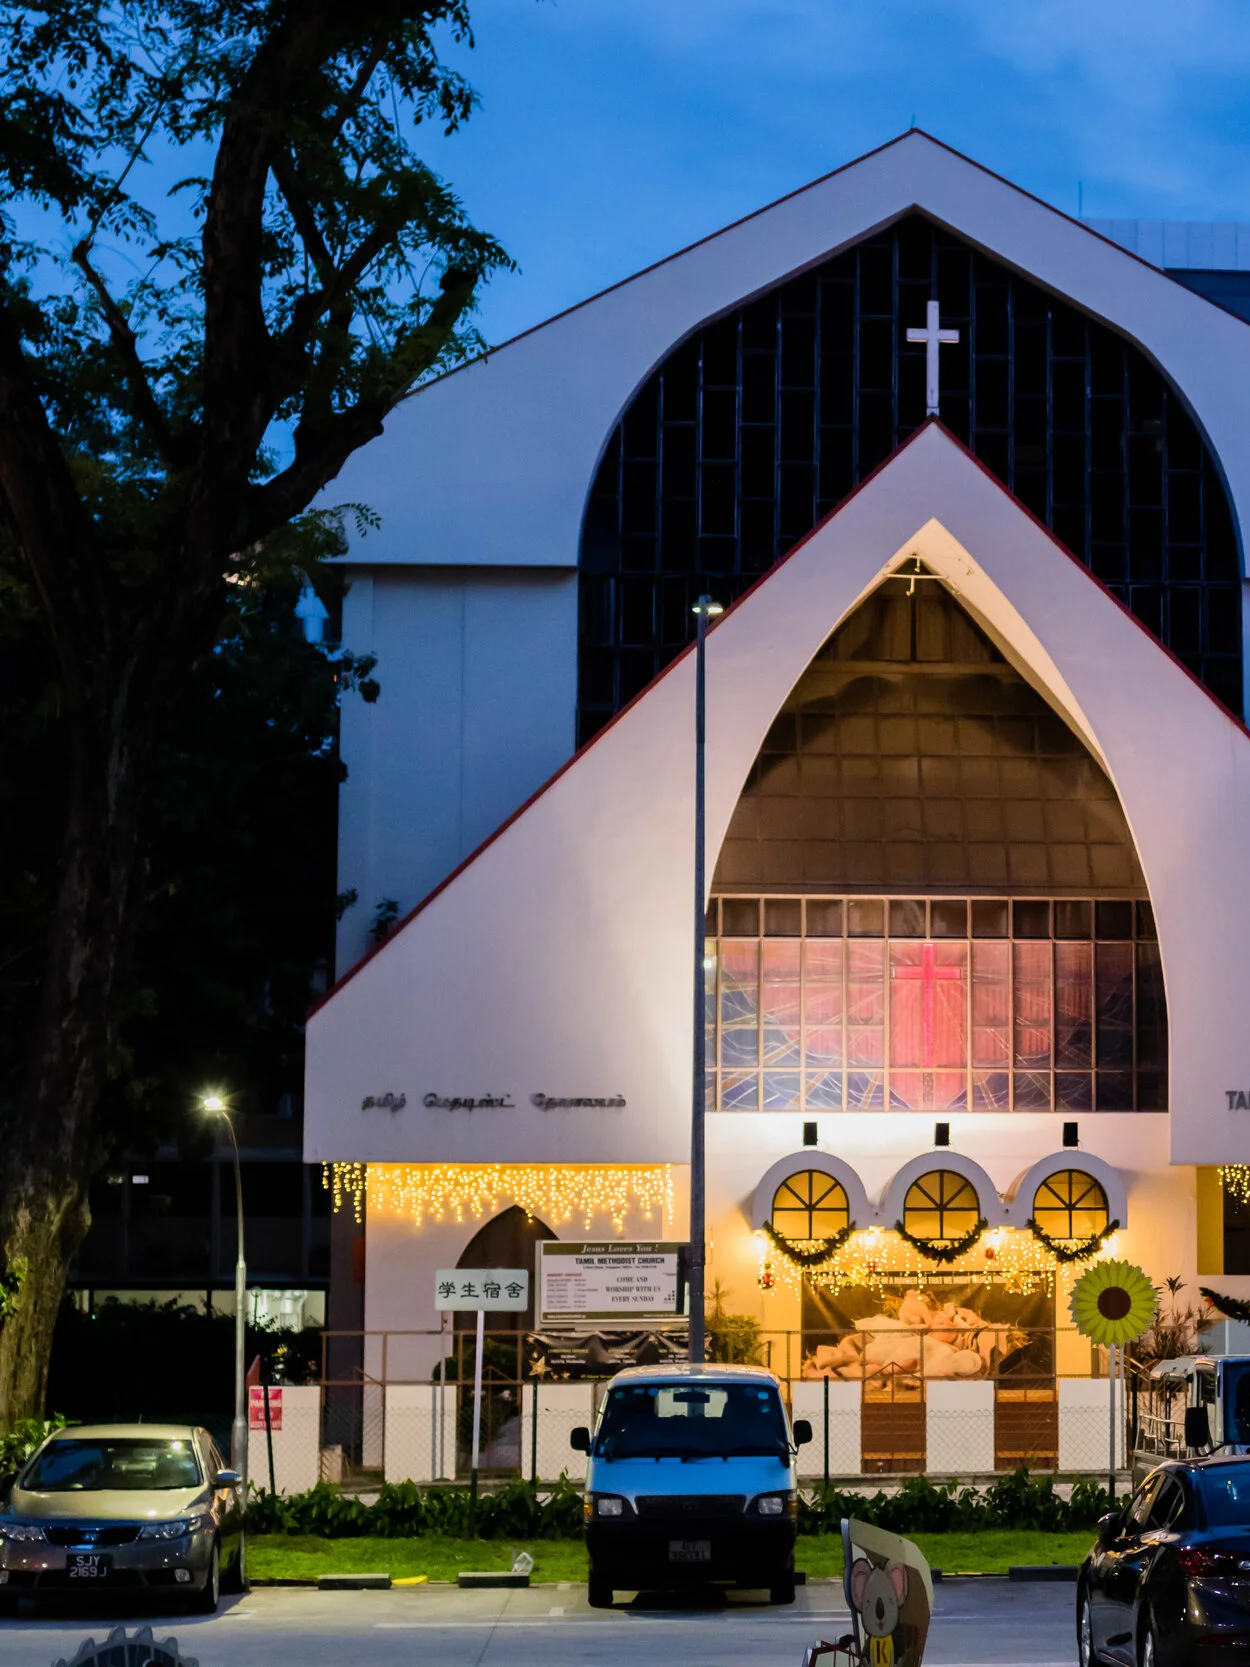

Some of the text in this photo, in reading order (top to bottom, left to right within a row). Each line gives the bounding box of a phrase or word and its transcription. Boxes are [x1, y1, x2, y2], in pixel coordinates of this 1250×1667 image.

[580, 1244, 605, 1254] Jesus
[608, 1244, 633, 1253] Loves
[636, 1244, 652, 1252] You
[575, 1256, 665, 1265] TAMIL METHODIST CHURCH
[438, 1281, 525, 1299] 学生宿舍
[250, 1399, 282, 1408] PARING
[76, 1555, 100, 1567] SJY
